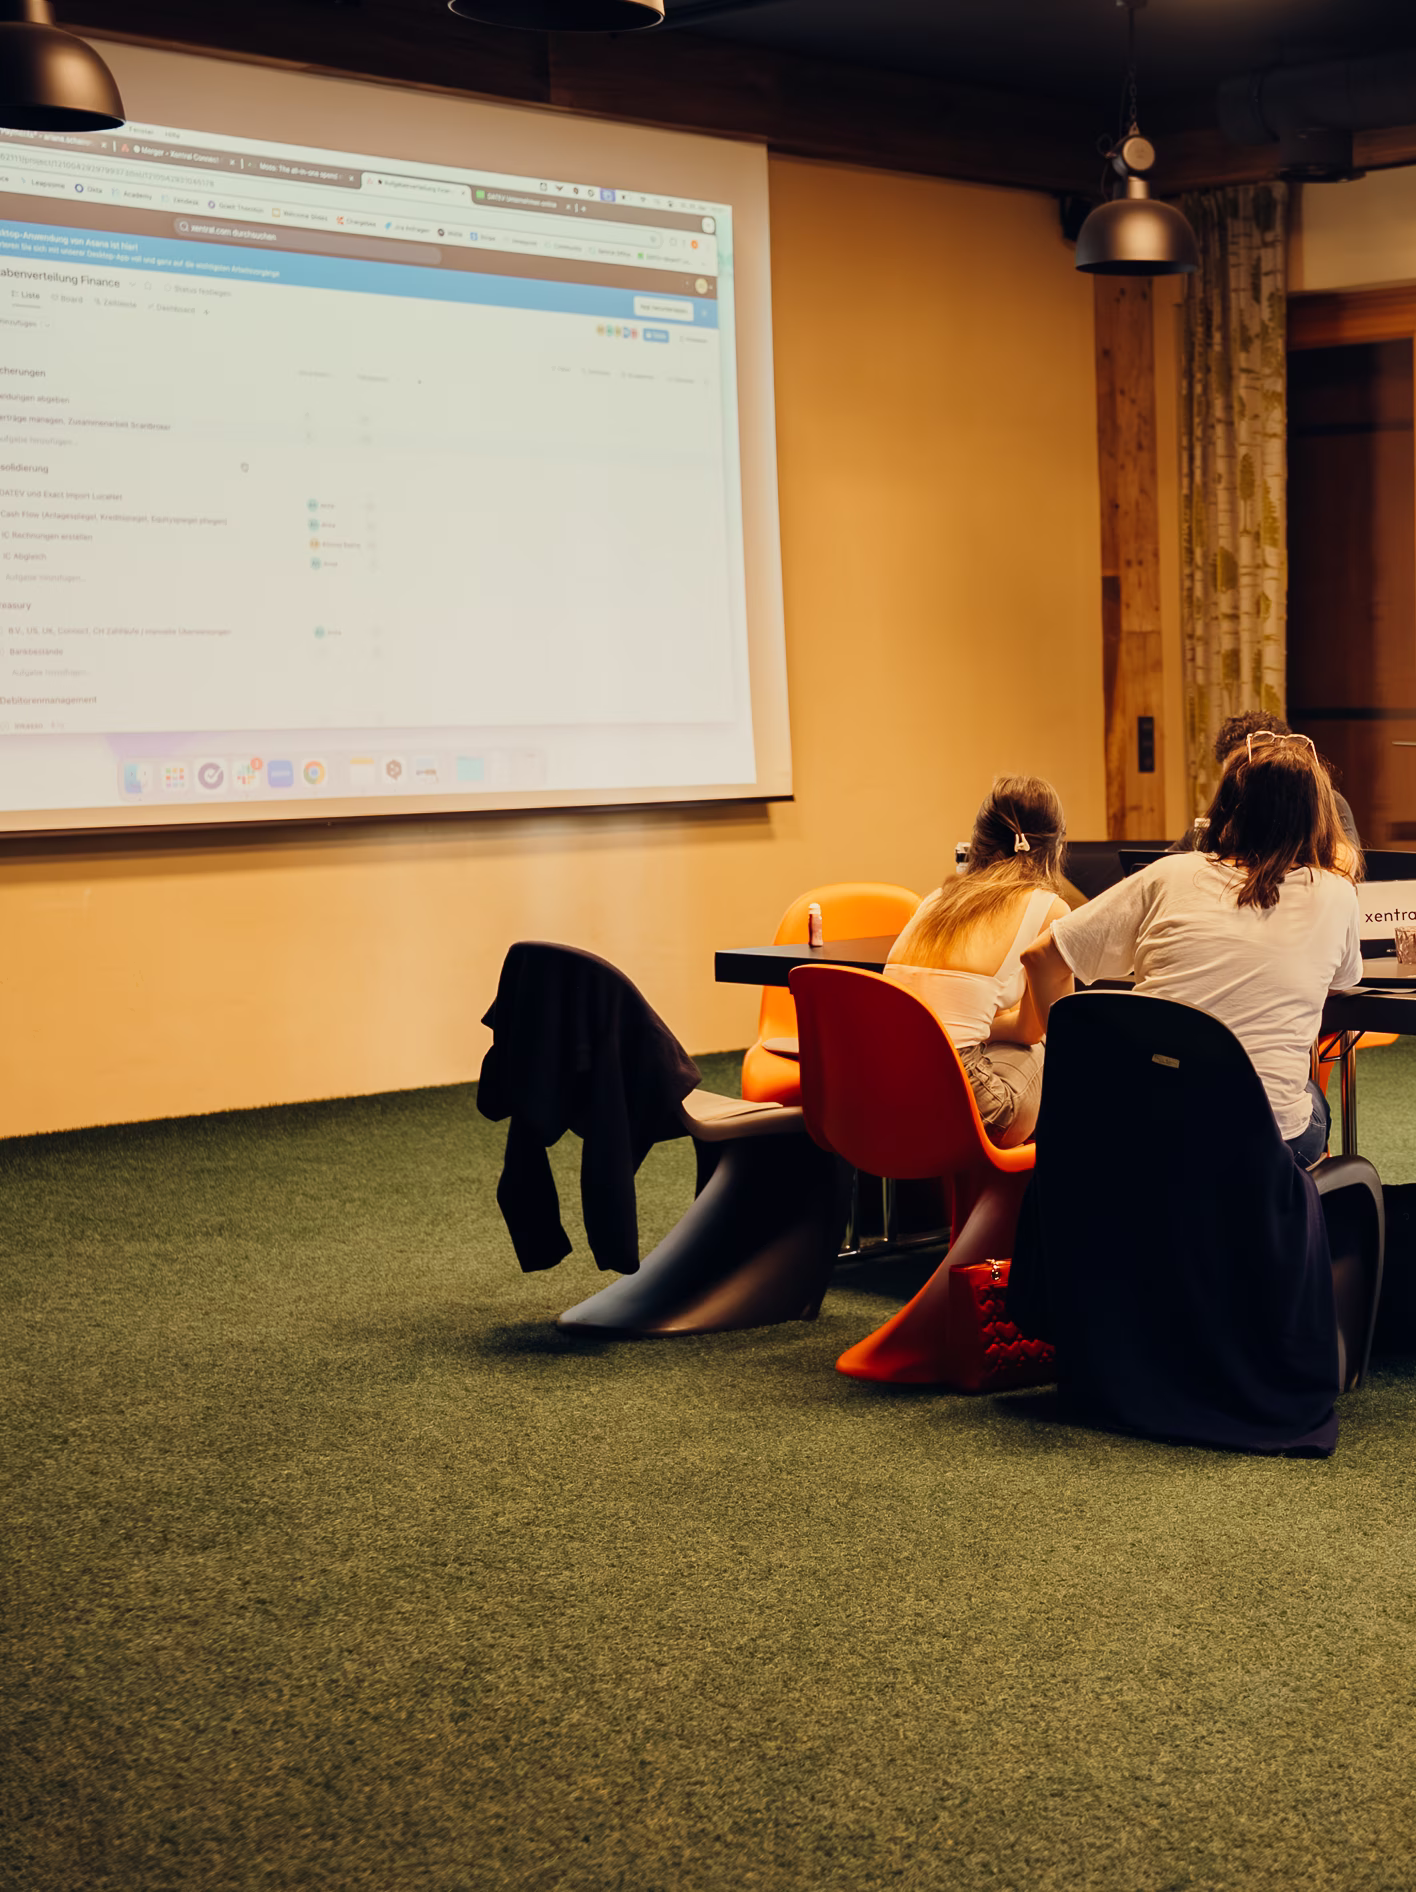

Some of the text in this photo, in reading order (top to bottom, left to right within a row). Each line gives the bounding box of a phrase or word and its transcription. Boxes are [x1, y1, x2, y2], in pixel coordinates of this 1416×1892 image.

[190, 222, 232, 237] xentral.com
[70, 237, 84, 246] von
[86, 238, 109, 249] Asana
[0, 268, 121, 289] abenverteilung Finance
[21, 291, 40, 300] Liste
[60, 294, 84, 304] Board
[0, 366, 47, 378] cherungen
[0, 462, 49, 475] solidierung
